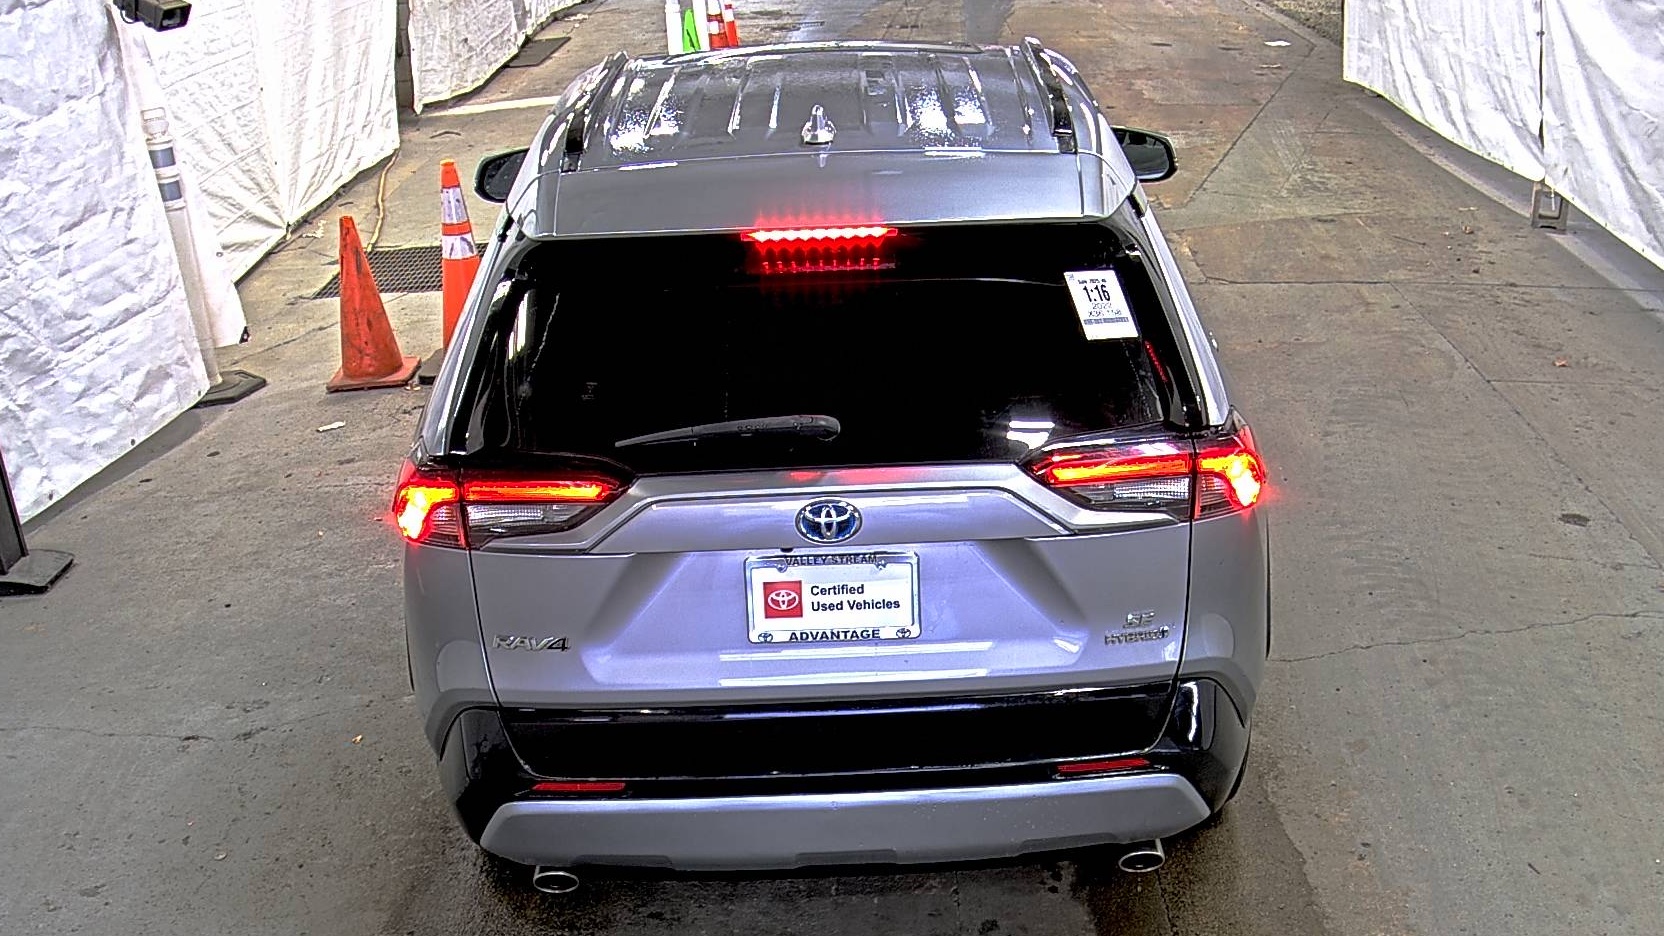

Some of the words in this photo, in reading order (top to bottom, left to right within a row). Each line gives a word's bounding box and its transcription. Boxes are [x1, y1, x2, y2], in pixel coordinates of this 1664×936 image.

[1083, 284, 1110, 302] 1:16
[784, 556, 828, 567] VALLEY
[831, 554, 877, 565] STREAM
[810, 584, 865, 596] Certified
[811, 599, 844, 612] Used
[847, 598, 900, 611] Vehicles
[788, 629, 881, 642] ADVANTAGE
[493, 634, 569, 652] RAV4
